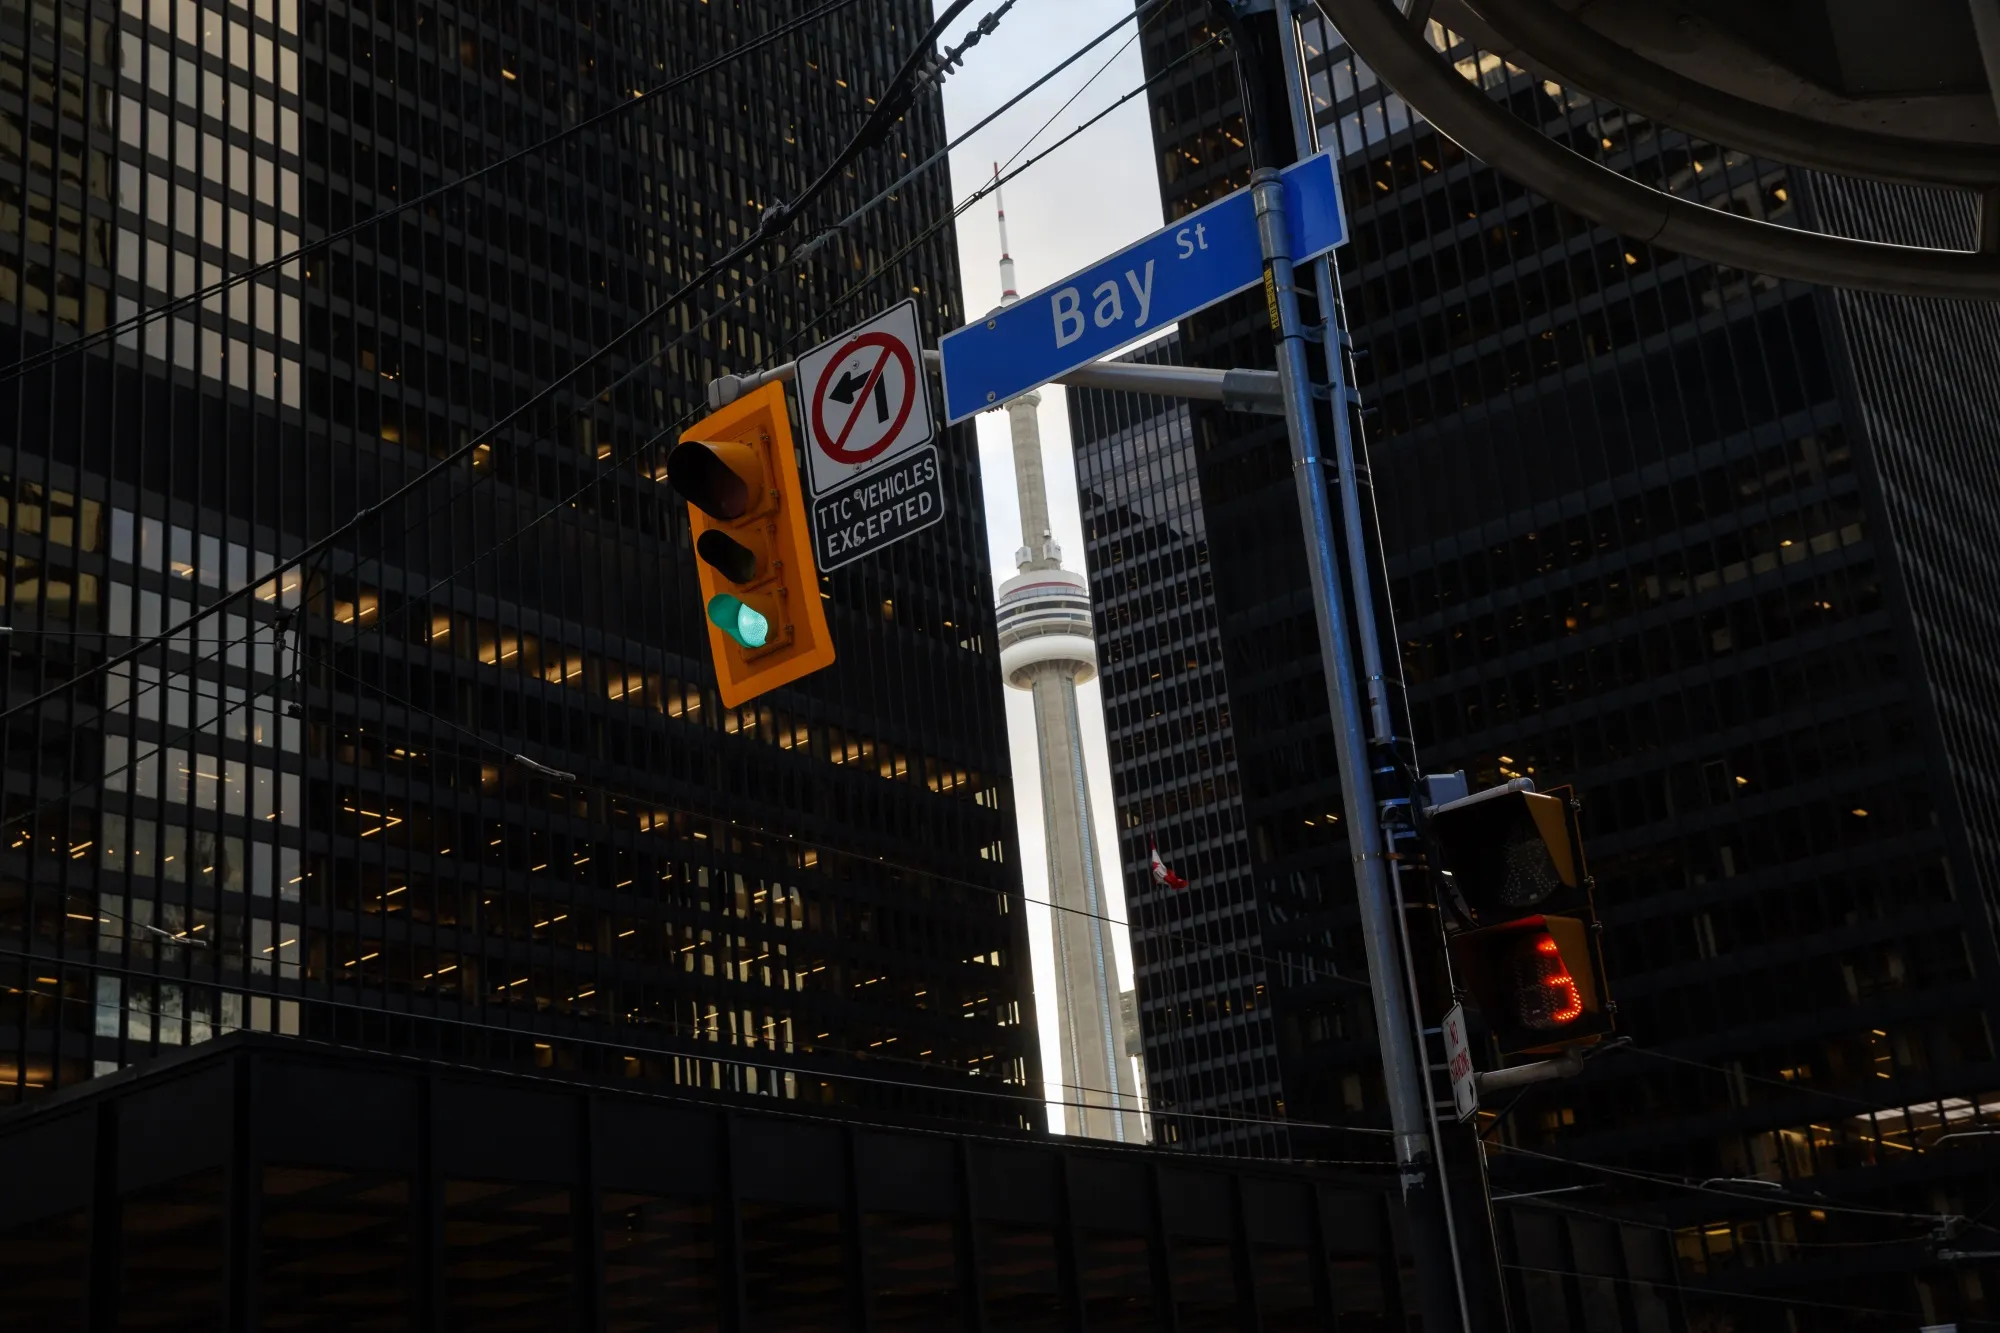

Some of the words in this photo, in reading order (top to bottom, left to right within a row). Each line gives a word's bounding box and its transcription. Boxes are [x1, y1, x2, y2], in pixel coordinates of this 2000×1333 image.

[1051, 259, 1154, 349] Bay
[1176, 223, 1208, 260] St
[818, 497, 852, 530] TTC
[857, 457, 935, 512] VEHICLES
[827, 491, 932, 558] EXCEPTED
[1449, 1020, 1459, 1048] NO
